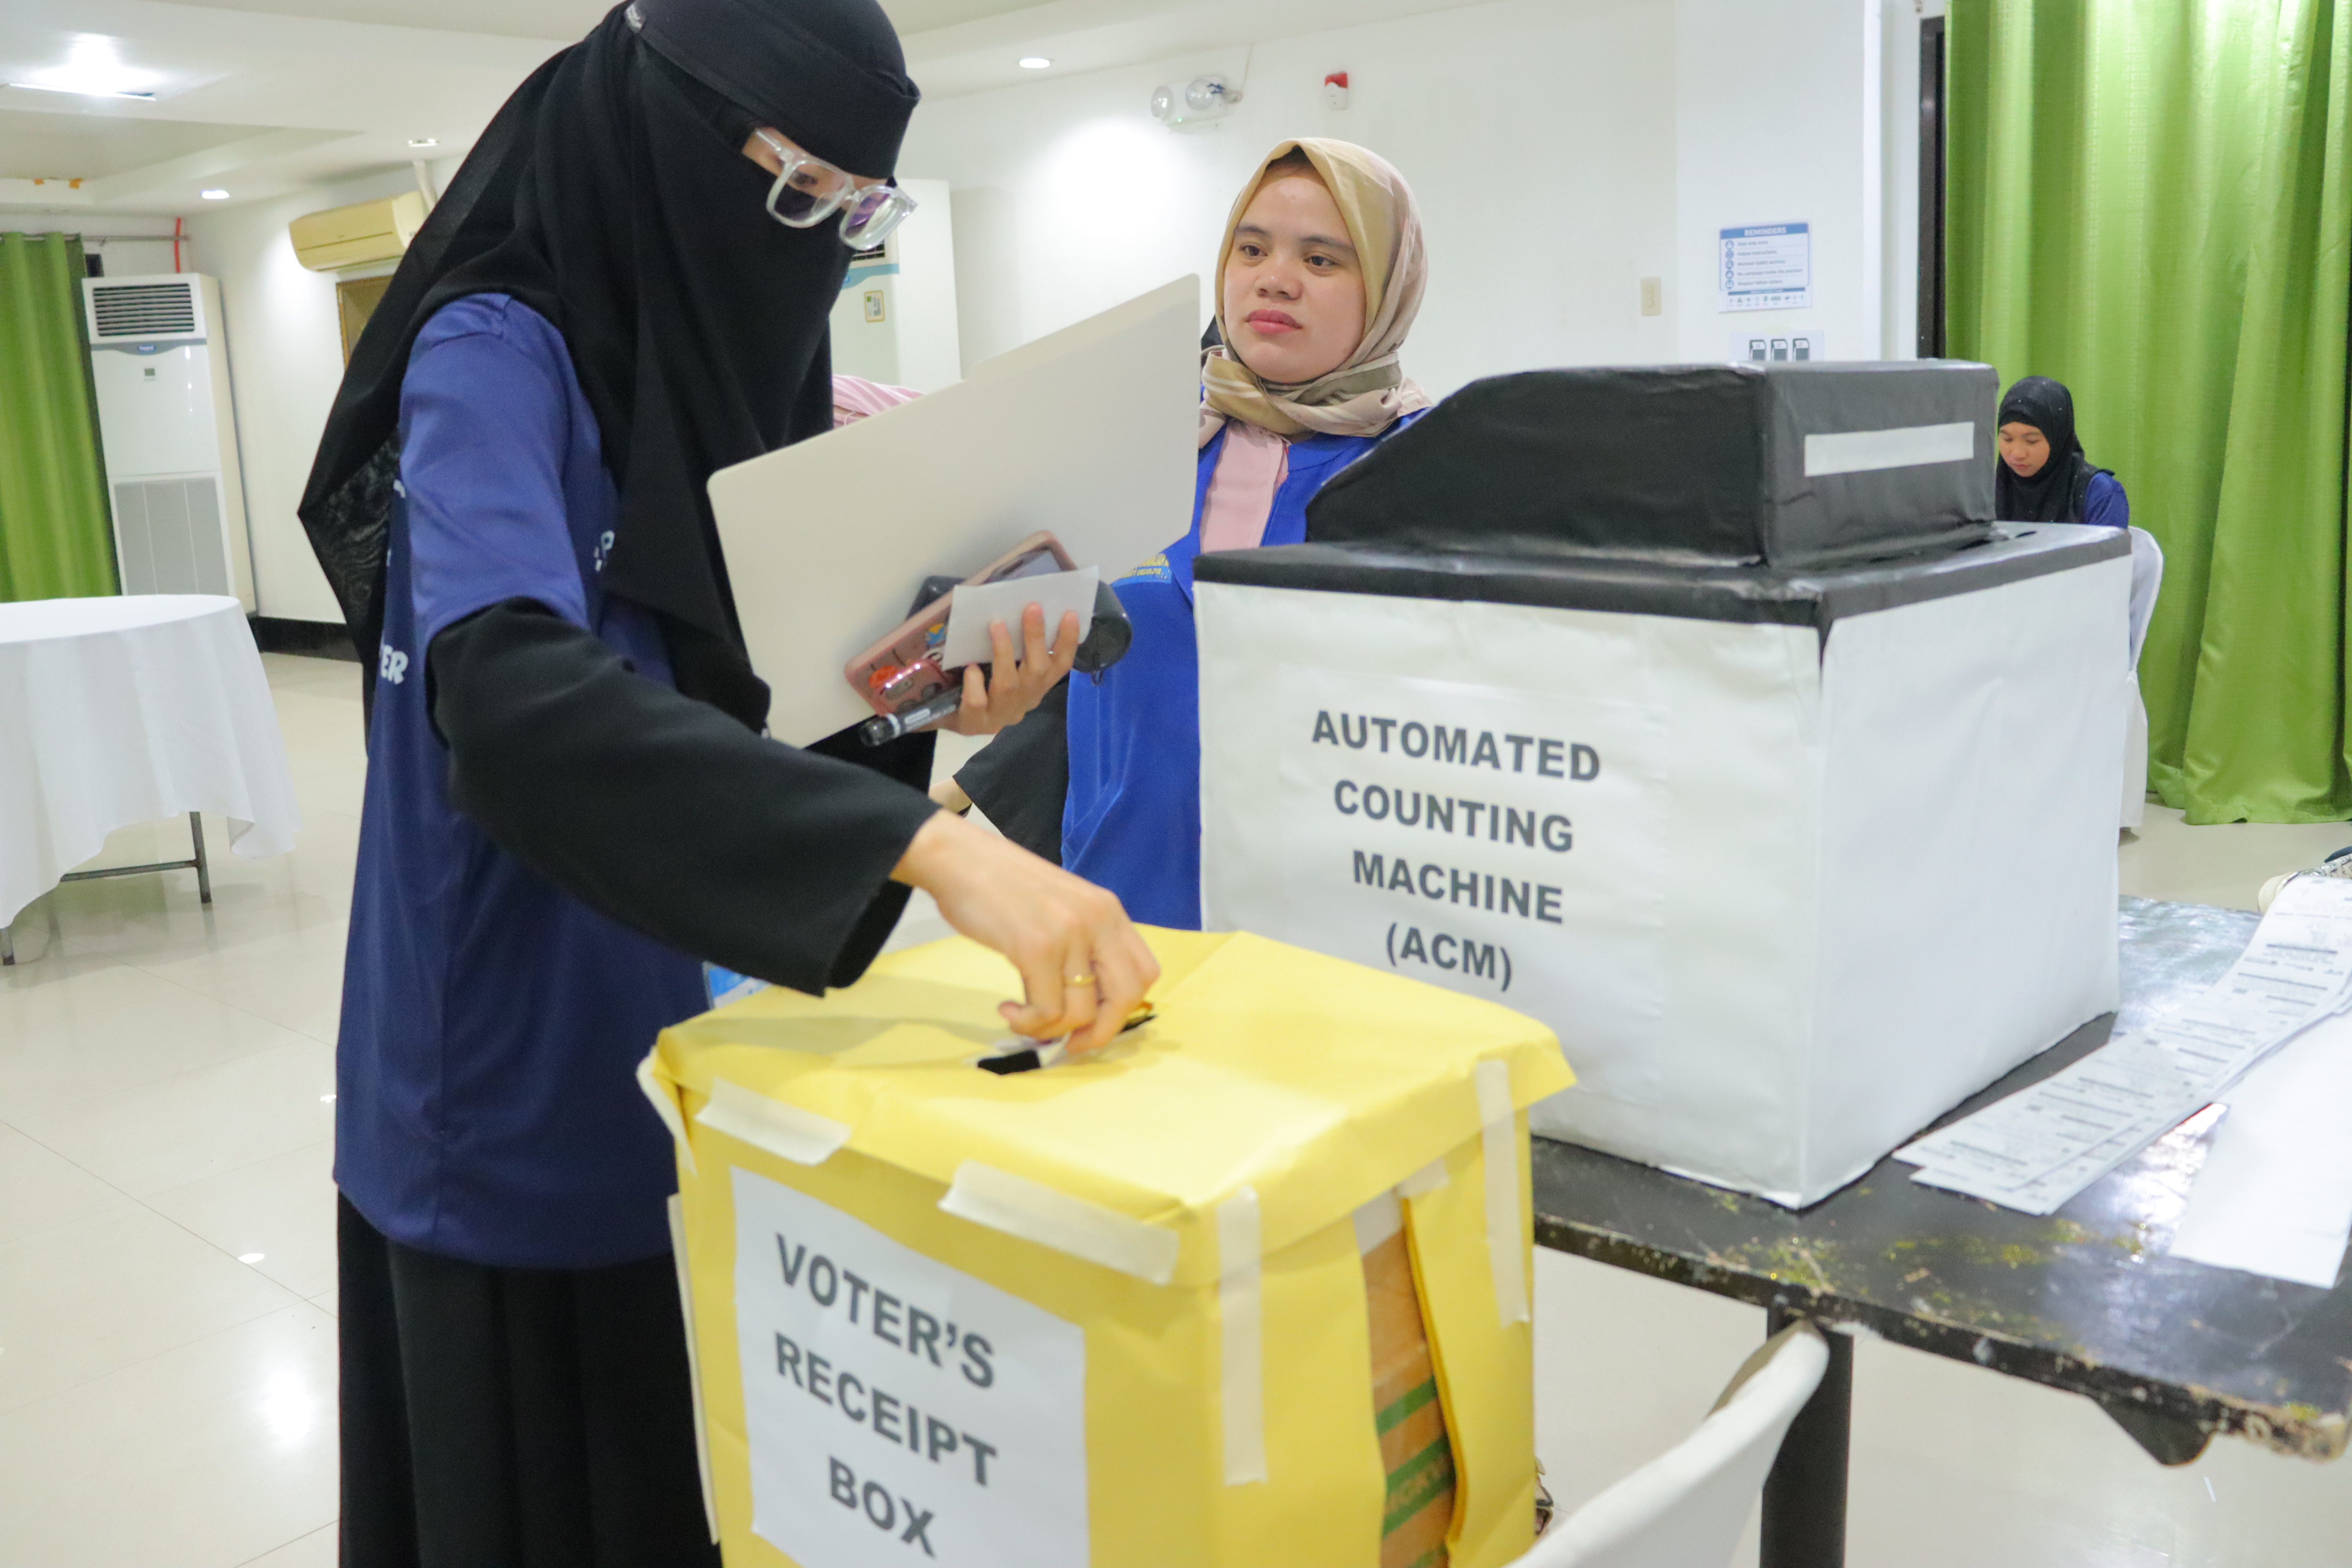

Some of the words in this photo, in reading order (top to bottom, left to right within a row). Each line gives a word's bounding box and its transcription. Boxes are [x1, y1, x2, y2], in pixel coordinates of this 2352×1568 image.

[1744, 227, 1786, 236] REMINDERS
[1312, 710, 1600, 781] AUTOMATED
[1334, 780, 1572, 853] COUNTING
[1353, 850, 1563, 924] MACHINE
[1386, 922, 1512, 993] (ACM)
[776, 1232, 994, 1388] VOTER’S
[776, 1332, 997, 1487] RECEIPT
[829, 1455, 935, 1558] BOX
